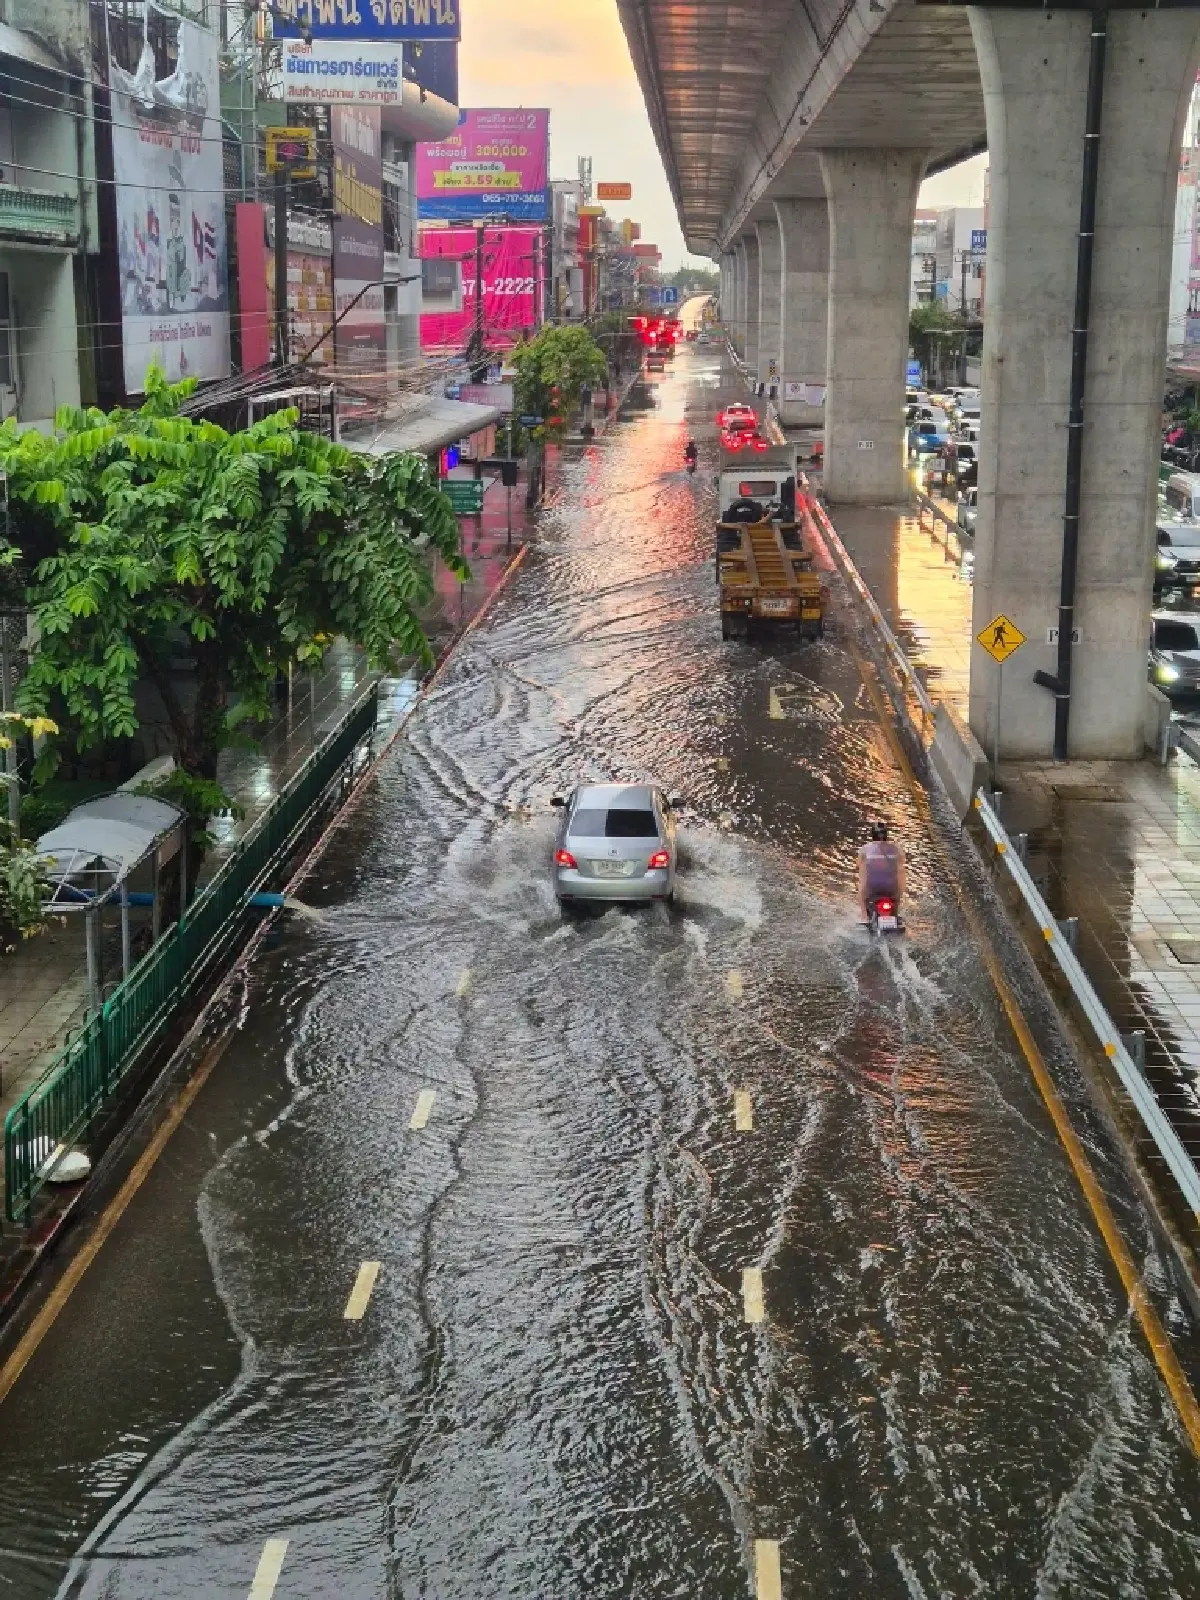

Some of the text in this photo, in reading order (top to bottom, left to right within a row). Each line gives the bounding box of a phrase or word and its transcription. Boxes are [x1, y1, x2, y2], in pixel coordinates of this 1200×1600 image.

[370, 0, 456, 25] จดฟน
[527, 113, 537, 129] 2
[464, 175, 493, 185] 3.59
[462, 277, 535, 295] 7-2222
